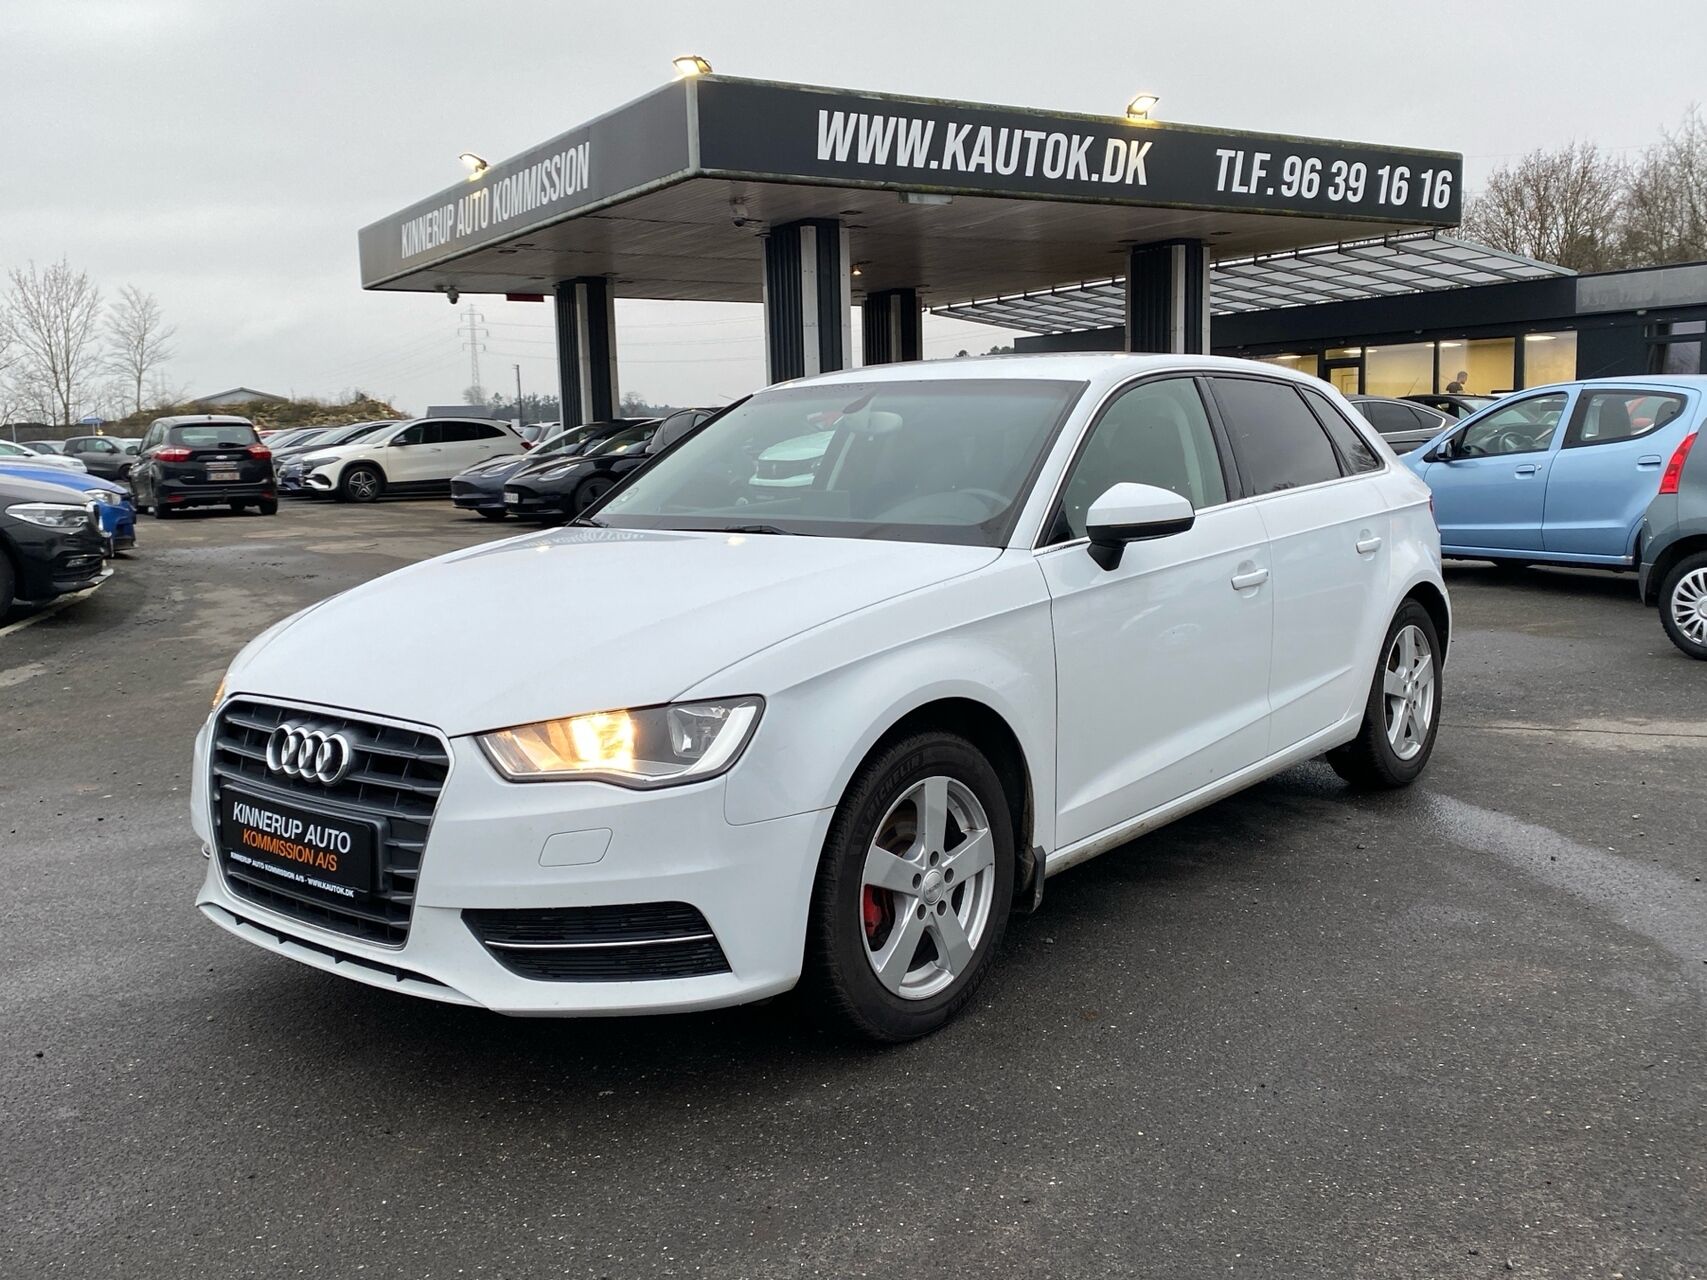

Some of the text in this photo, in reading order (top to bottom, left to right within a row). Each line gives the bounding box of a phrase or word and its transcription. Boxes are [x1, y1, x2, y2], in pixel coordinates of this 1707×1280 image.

[817, 109, 1153, 186] WWW.KAUTOK.DK
[402, 141, 590, 259] KINNERUP AUTO KOMMISSION
[1216, 148, 1453, 209] TLF. 96 39 16 16
[232, 801, 351, 854] KINNERUP AUTO
[242, 828, 337, 871] KOMMISSION A/S
[307, 877, 355, 898] WWW.KAUTOK.DK
